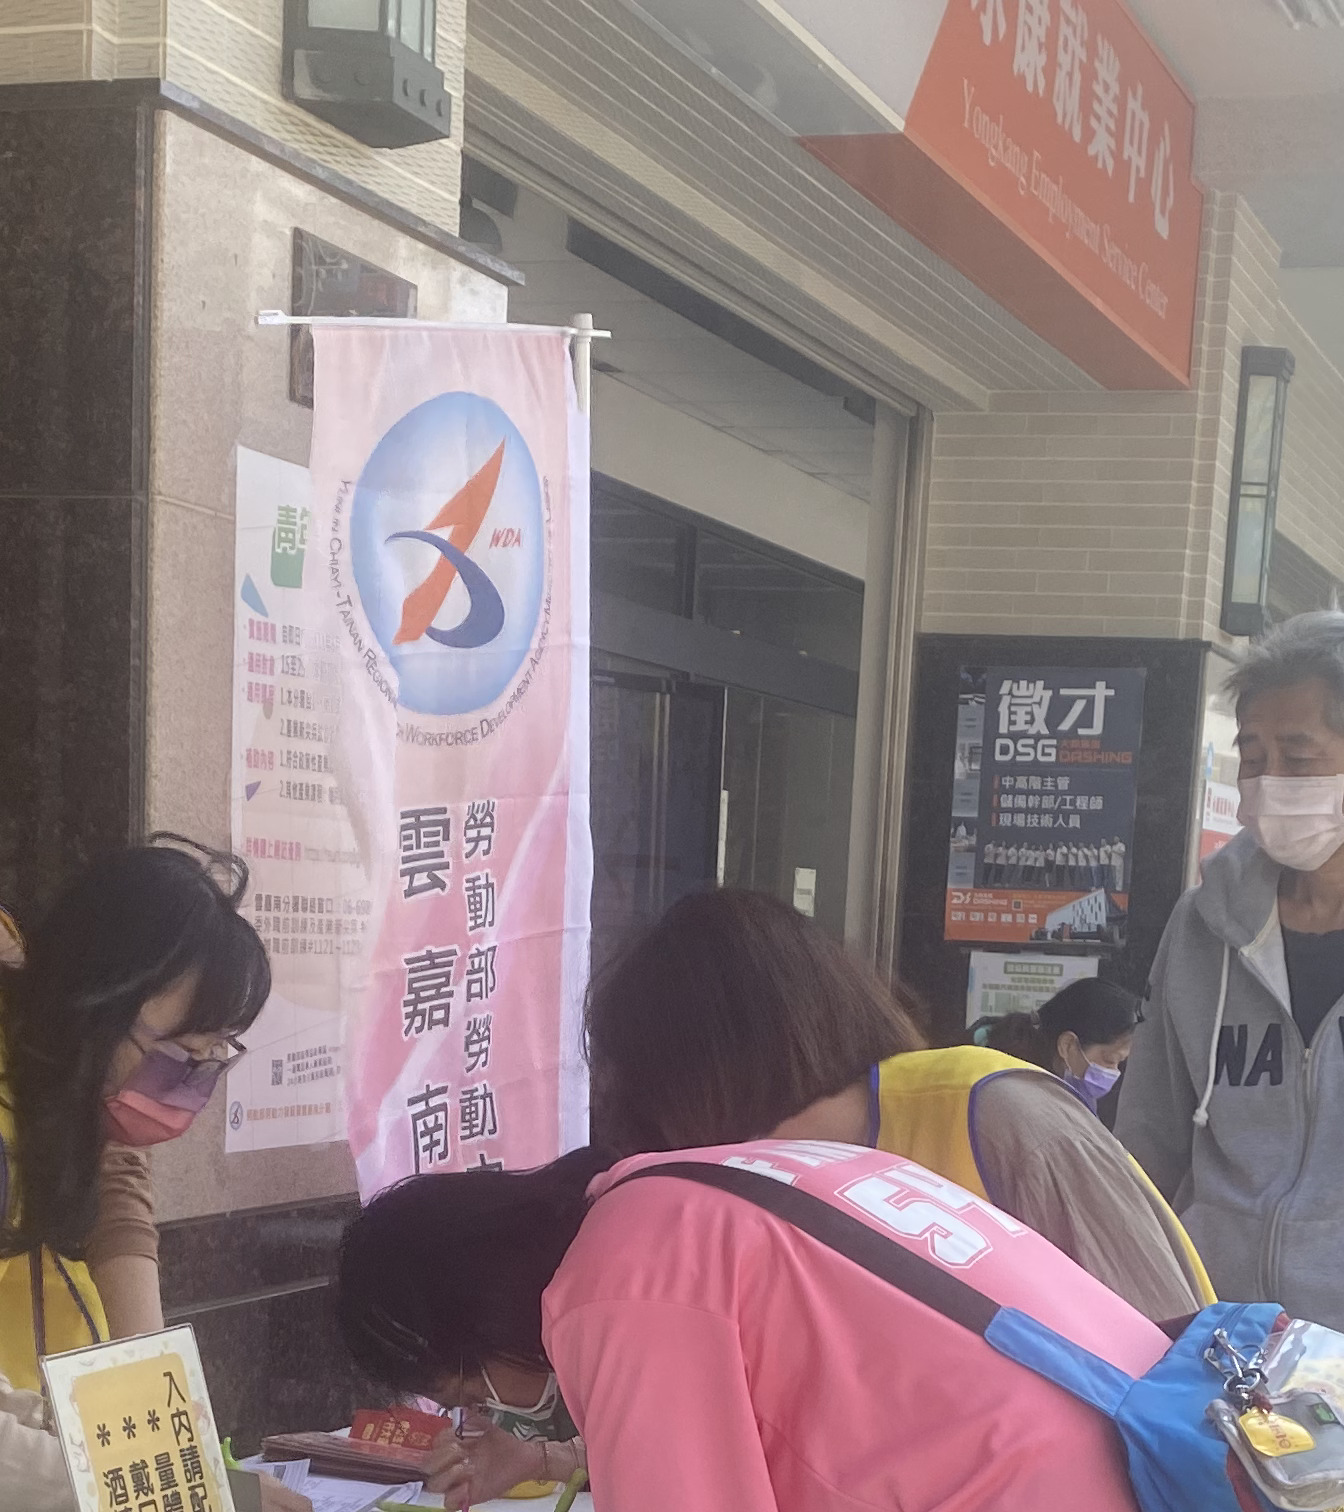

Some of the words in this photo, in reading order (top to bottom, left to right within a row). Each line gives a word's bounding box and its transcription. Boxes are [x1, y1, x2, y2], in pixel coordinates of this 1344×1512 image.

[963, 77, 1028, 196] Yongkang
[1030, 148, 1102, 256] Employment
[1101, 223, 1139, 291] Service
[1138, 261, 1170, 320] Center
[970, 0, 1174, 239] 康就業中心
[994, 738, 1057, 762] DSG
[997, 680, 1115, 736] 徵才
[399, 805, 459, 1175] 雲嘉南
